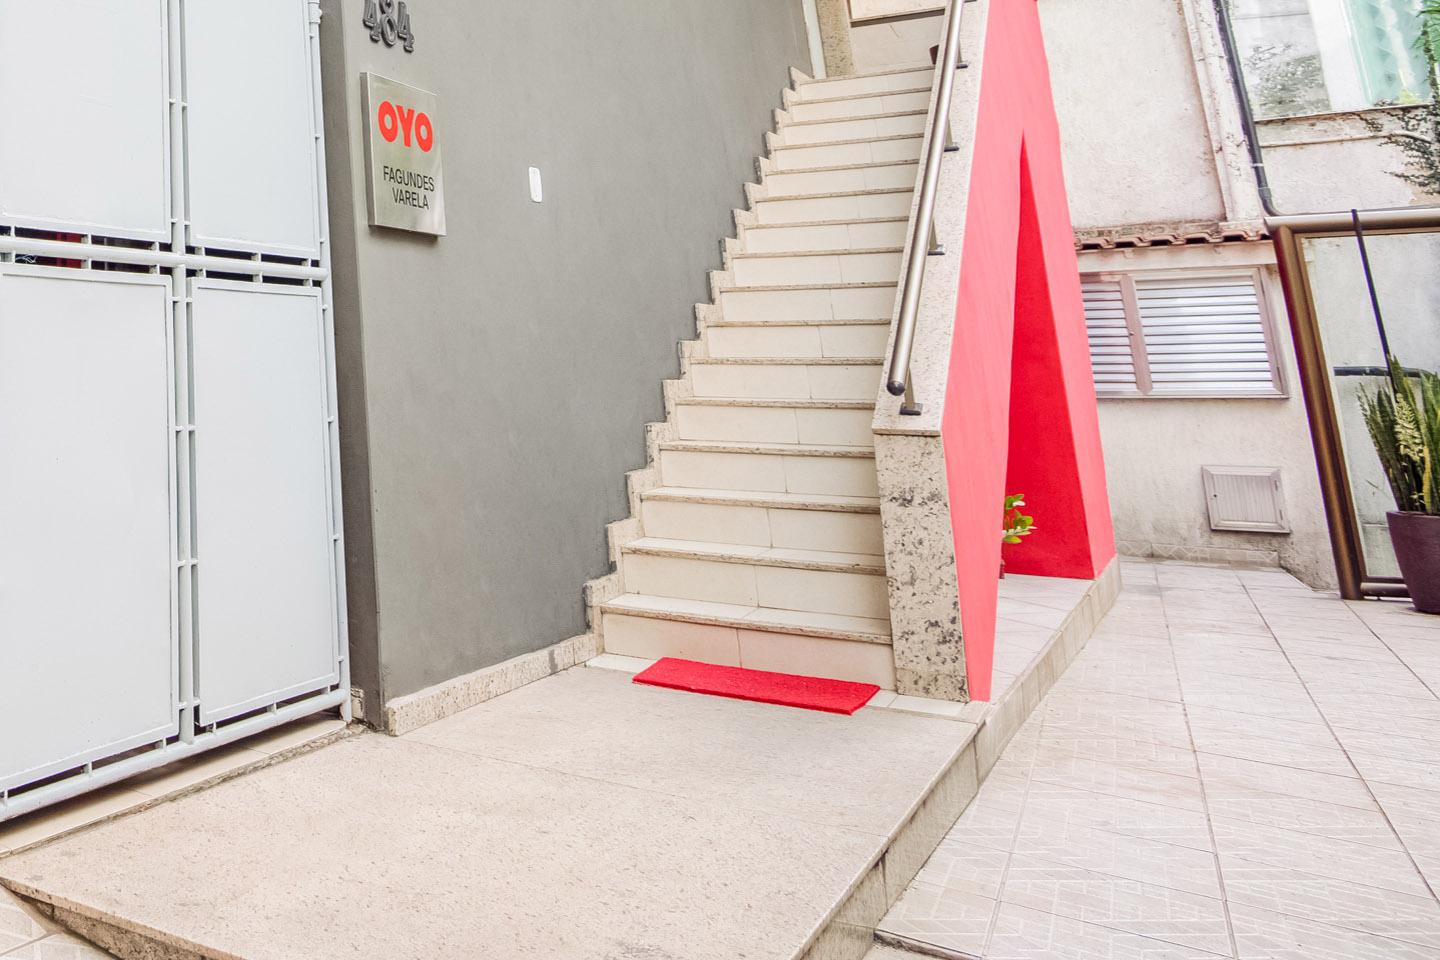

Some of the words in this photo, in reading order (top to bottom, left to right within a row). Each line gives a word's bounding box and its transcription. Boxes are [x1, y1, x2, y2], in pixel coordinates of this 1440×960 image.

[378, 100, 433, 152] OYO
[383, 165, 435, 192] FAGUNDES
[392, 187, 429, 210] VARELA
